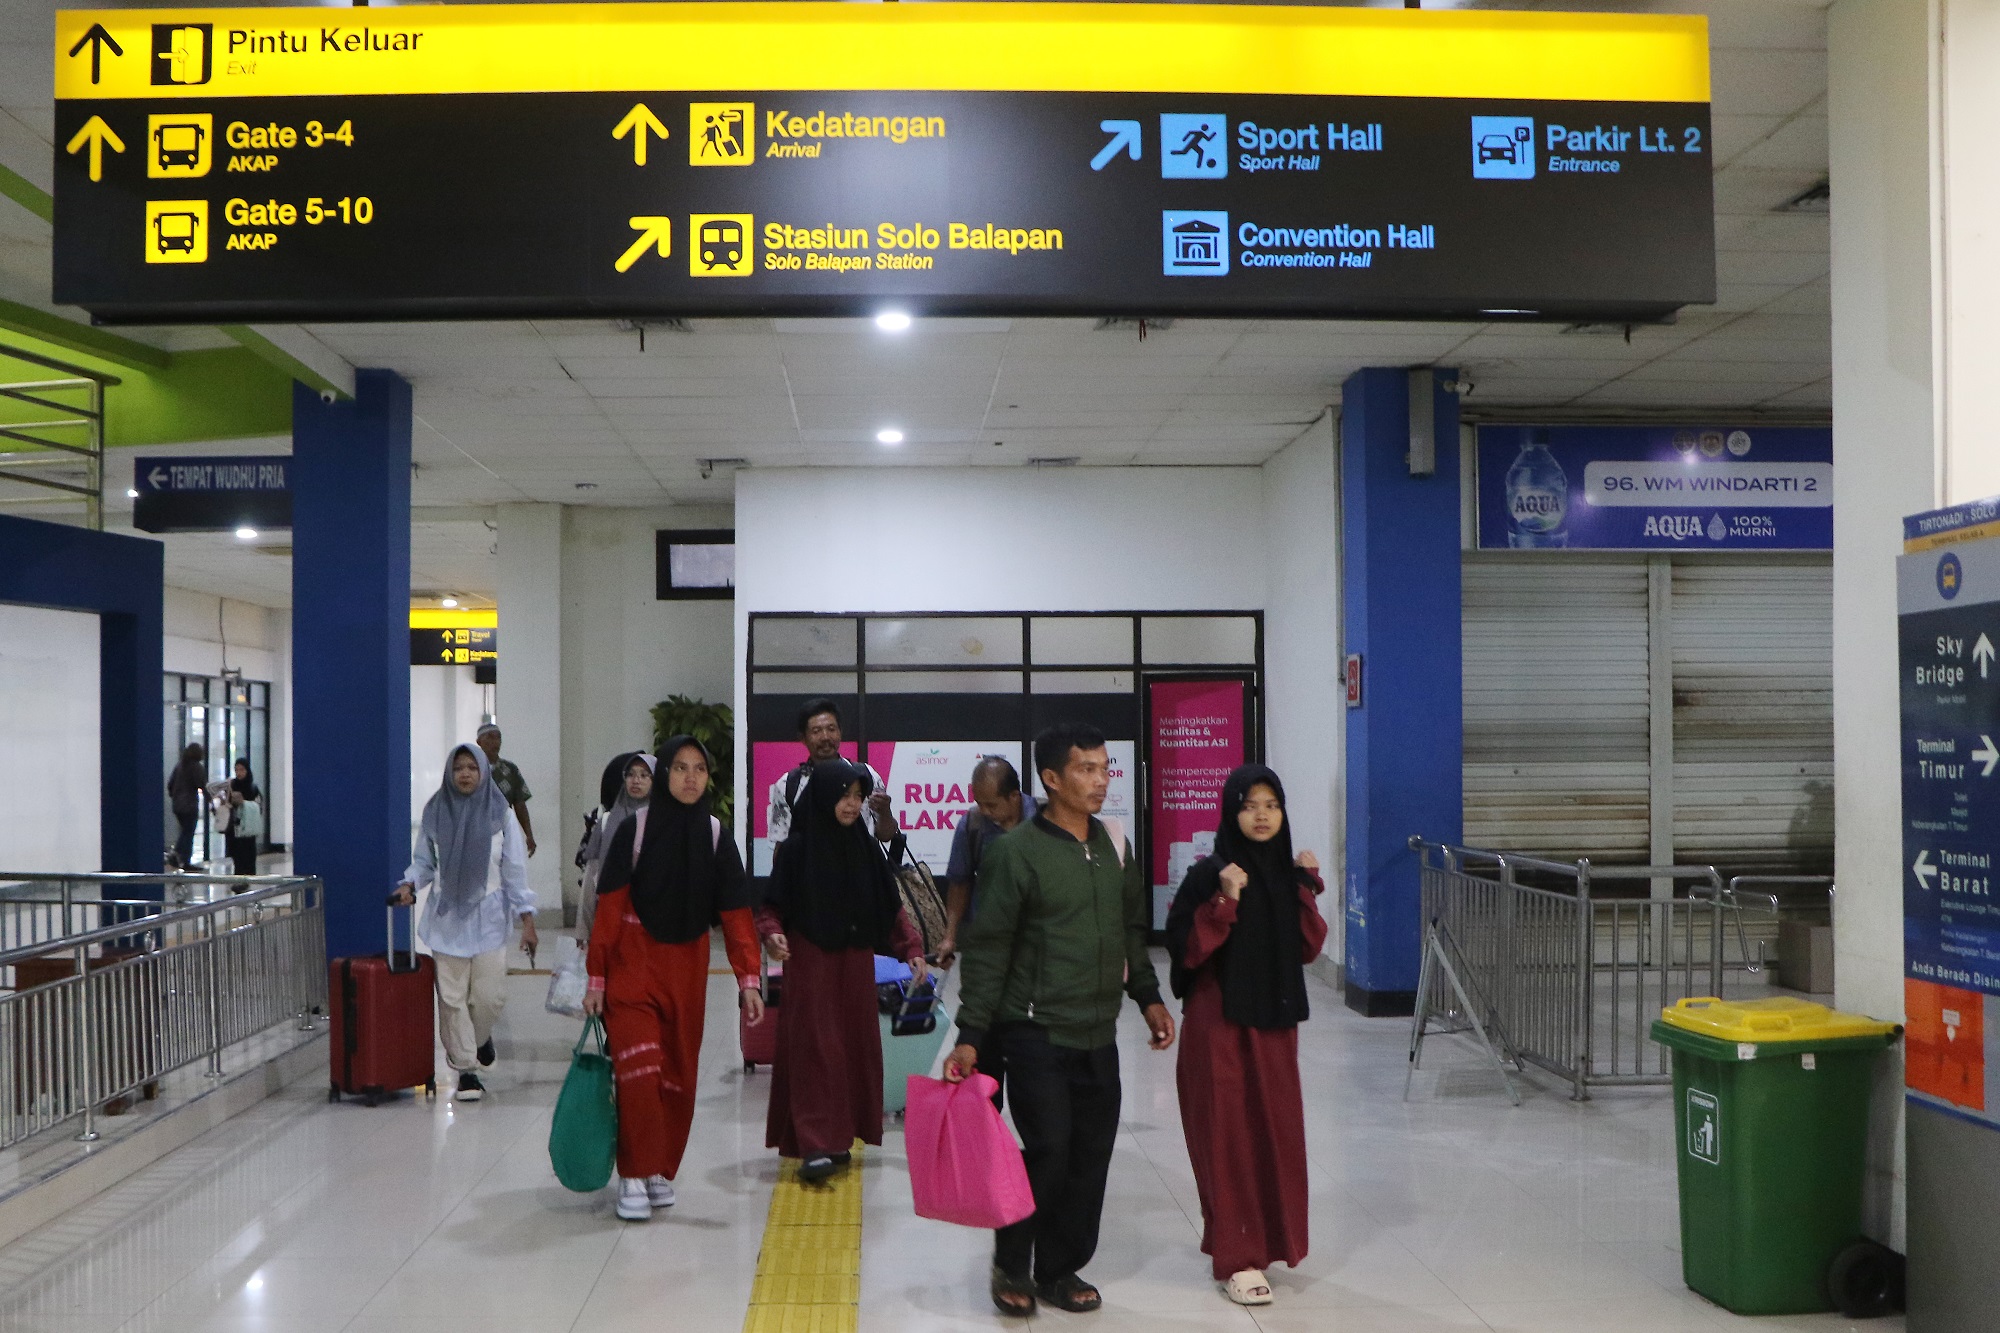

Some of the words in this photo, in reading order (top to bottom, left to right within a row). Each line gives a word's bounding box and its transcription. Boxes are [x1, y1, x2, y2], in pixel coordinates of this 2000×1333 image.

[227, 27, 307, 54] Pintu
[320, 27, 424, 53] Keluar
[226, 60, 258, 76] Exit
[225, 120, 297, 149] Gate
[304, 119, 355, 147] 3-4
[766, 110, 945, 143] Kedatangan
[1238, 122, 1319, 155] Sport
[1328, 123, 1383, 151] Hall
[1546, 124, 1630, 152] Parkir
[1639, 126, 1675, 153] Lt.
[1684, 127, 1702, 153] 2
[766, 142, 822, 159] Arrival
[226, 155, 279, 172] AKAP
[1238, 154, 1289, 175] Sport
[1292, 154, 1321, 171] Hall
[1548, 156, 1621, 174] Entrance
[224, 198, 297, 226] Gate
[304, 196, 374, 225] 5-10
[226, 233, 278, 250] AKAP
[763, 222, 869, 250] Stasiun
[877, 222, 940, 250] Solo
[948, 223, 1063, 256] Balapan
[1238, 221, 1380, 249] Convention
[1388, 223, 1435, 250] Hall
[764, 253, 802, 270] Solo
[805, 253, 872, 274] Balapan
[874, 253, 933, 270] Station
[1240, 251, 1335, 269] Convention
[1338, 251, 1372, 268] Hall
[170, 465, 213, 488] TEMPAT
[215, 465, 256, 488] WUDHU
[258, 465, 285, 488] PRIA
[1603, 476, 1639, 491] 96.
[1644, 477, 1683, 491] WM
[1690, 477, 1798, 491] WINDARTI
[1804, 477, 1818, 491] 2
[1515, 495, 1561, 516] AQUA
[1643, 515, 1704, 541] AQUA
[1733, 516, 1773, 527] 100%
[1919, 511, 1964, 532] TIRTONADI
[1970, 504, 1997, 521] SOLO
[1730, 527, 1776, 537] MURNI
[1936, 635, 1963, 659] Sky
[1916, 663, 1964, 688] Bridge
[1160, 715, 1229, 727] Meningkatkan
[1160, 726, 1201, 736] Kualitas
[1203, 726, 1211, 736] &
[1160, 738, 1210, 747] Kuantitas
[1211, 738, 1229, 747] ASI
[1917, 738, 1955, 755] Terminal
[1162, 766, 1232, 777] Mempercepat
[1919, 759, 1965, 780] Timur
[1162, 777, 1227, 789] Penyembuha
[1162, 789, 1186, 799] Luka
[1188, 789, 1219, 799] Pasca
[1162, 800, 1217, 810] Persalinan
[1940, 849, 1990, 869] Terminal
[1940, 871, 1989, 895] Barat
[1912, 960, 1935, 976] Anda
[1937, 964, 1971, 983] Berada
[1973, 971, 2000, 989] Disin
